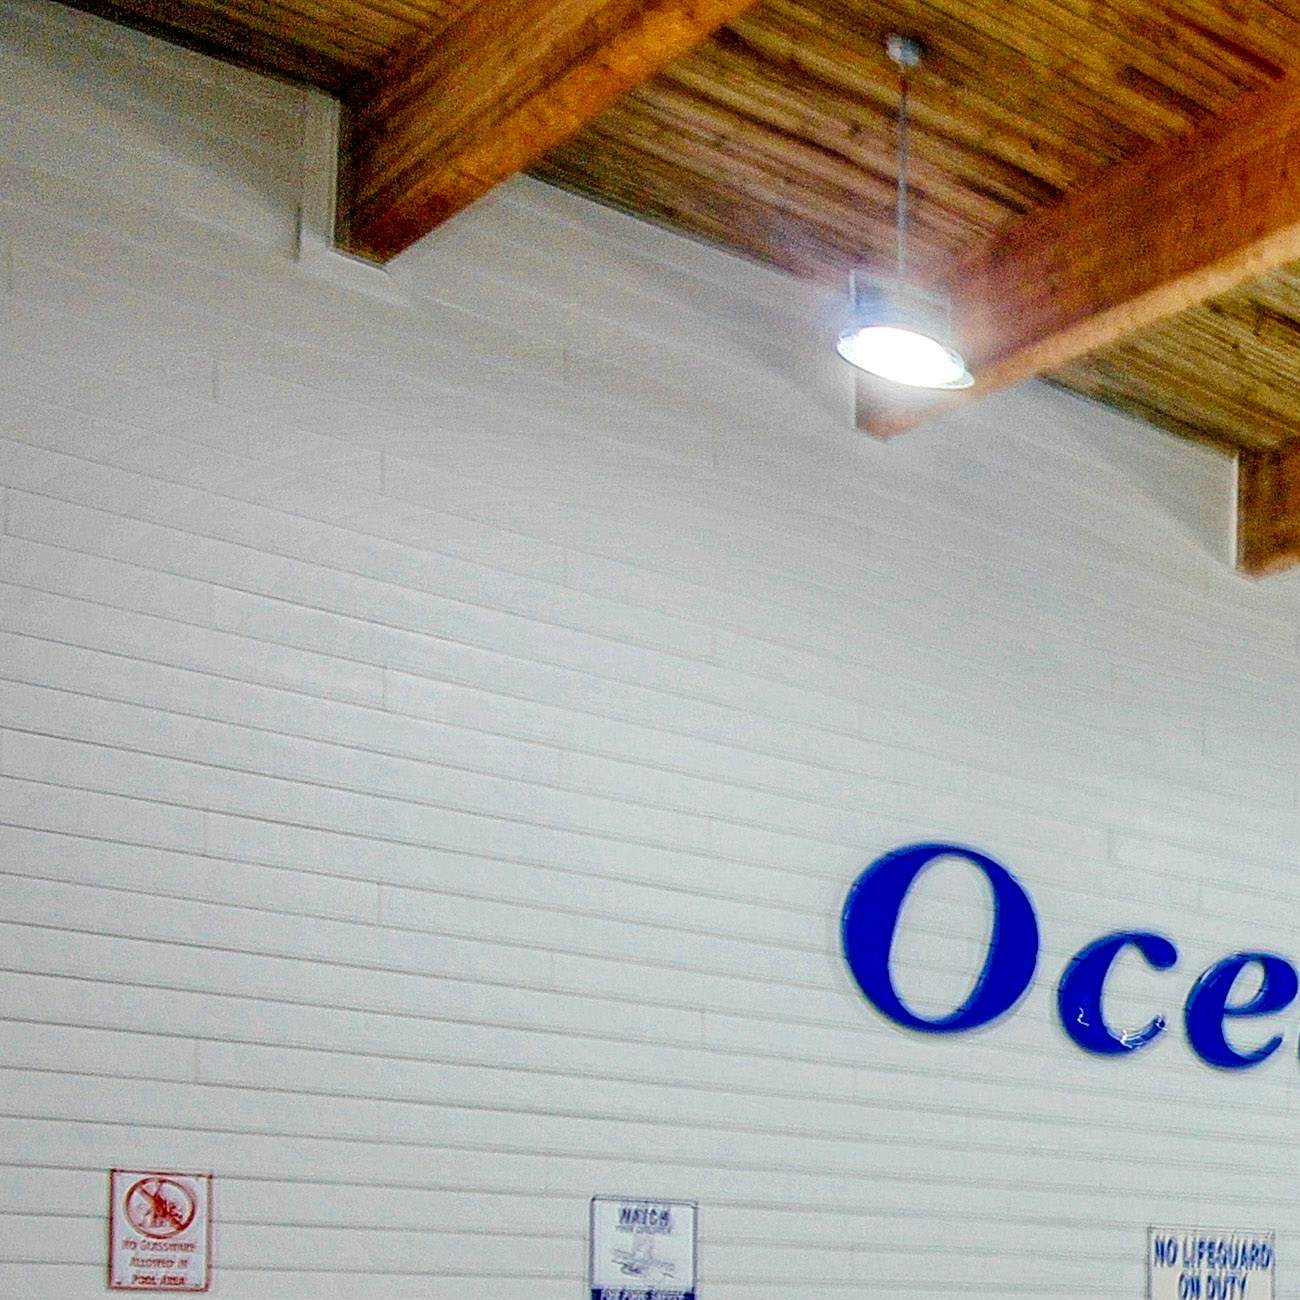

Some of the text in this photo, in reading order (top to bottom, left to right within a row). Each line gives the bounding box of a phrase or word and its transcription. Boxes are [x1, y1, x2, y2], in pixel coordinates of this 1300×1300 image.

[619, 1208, 670, 1227] WATCH
[122, 1239, 137, 1250] NO
[1153, 1235, 1273, 1270] NO LIFEGUARD
[130, 1257, 175, 1268] ALLOWED
[132, 1274, 185, 1286] POOL AREA
